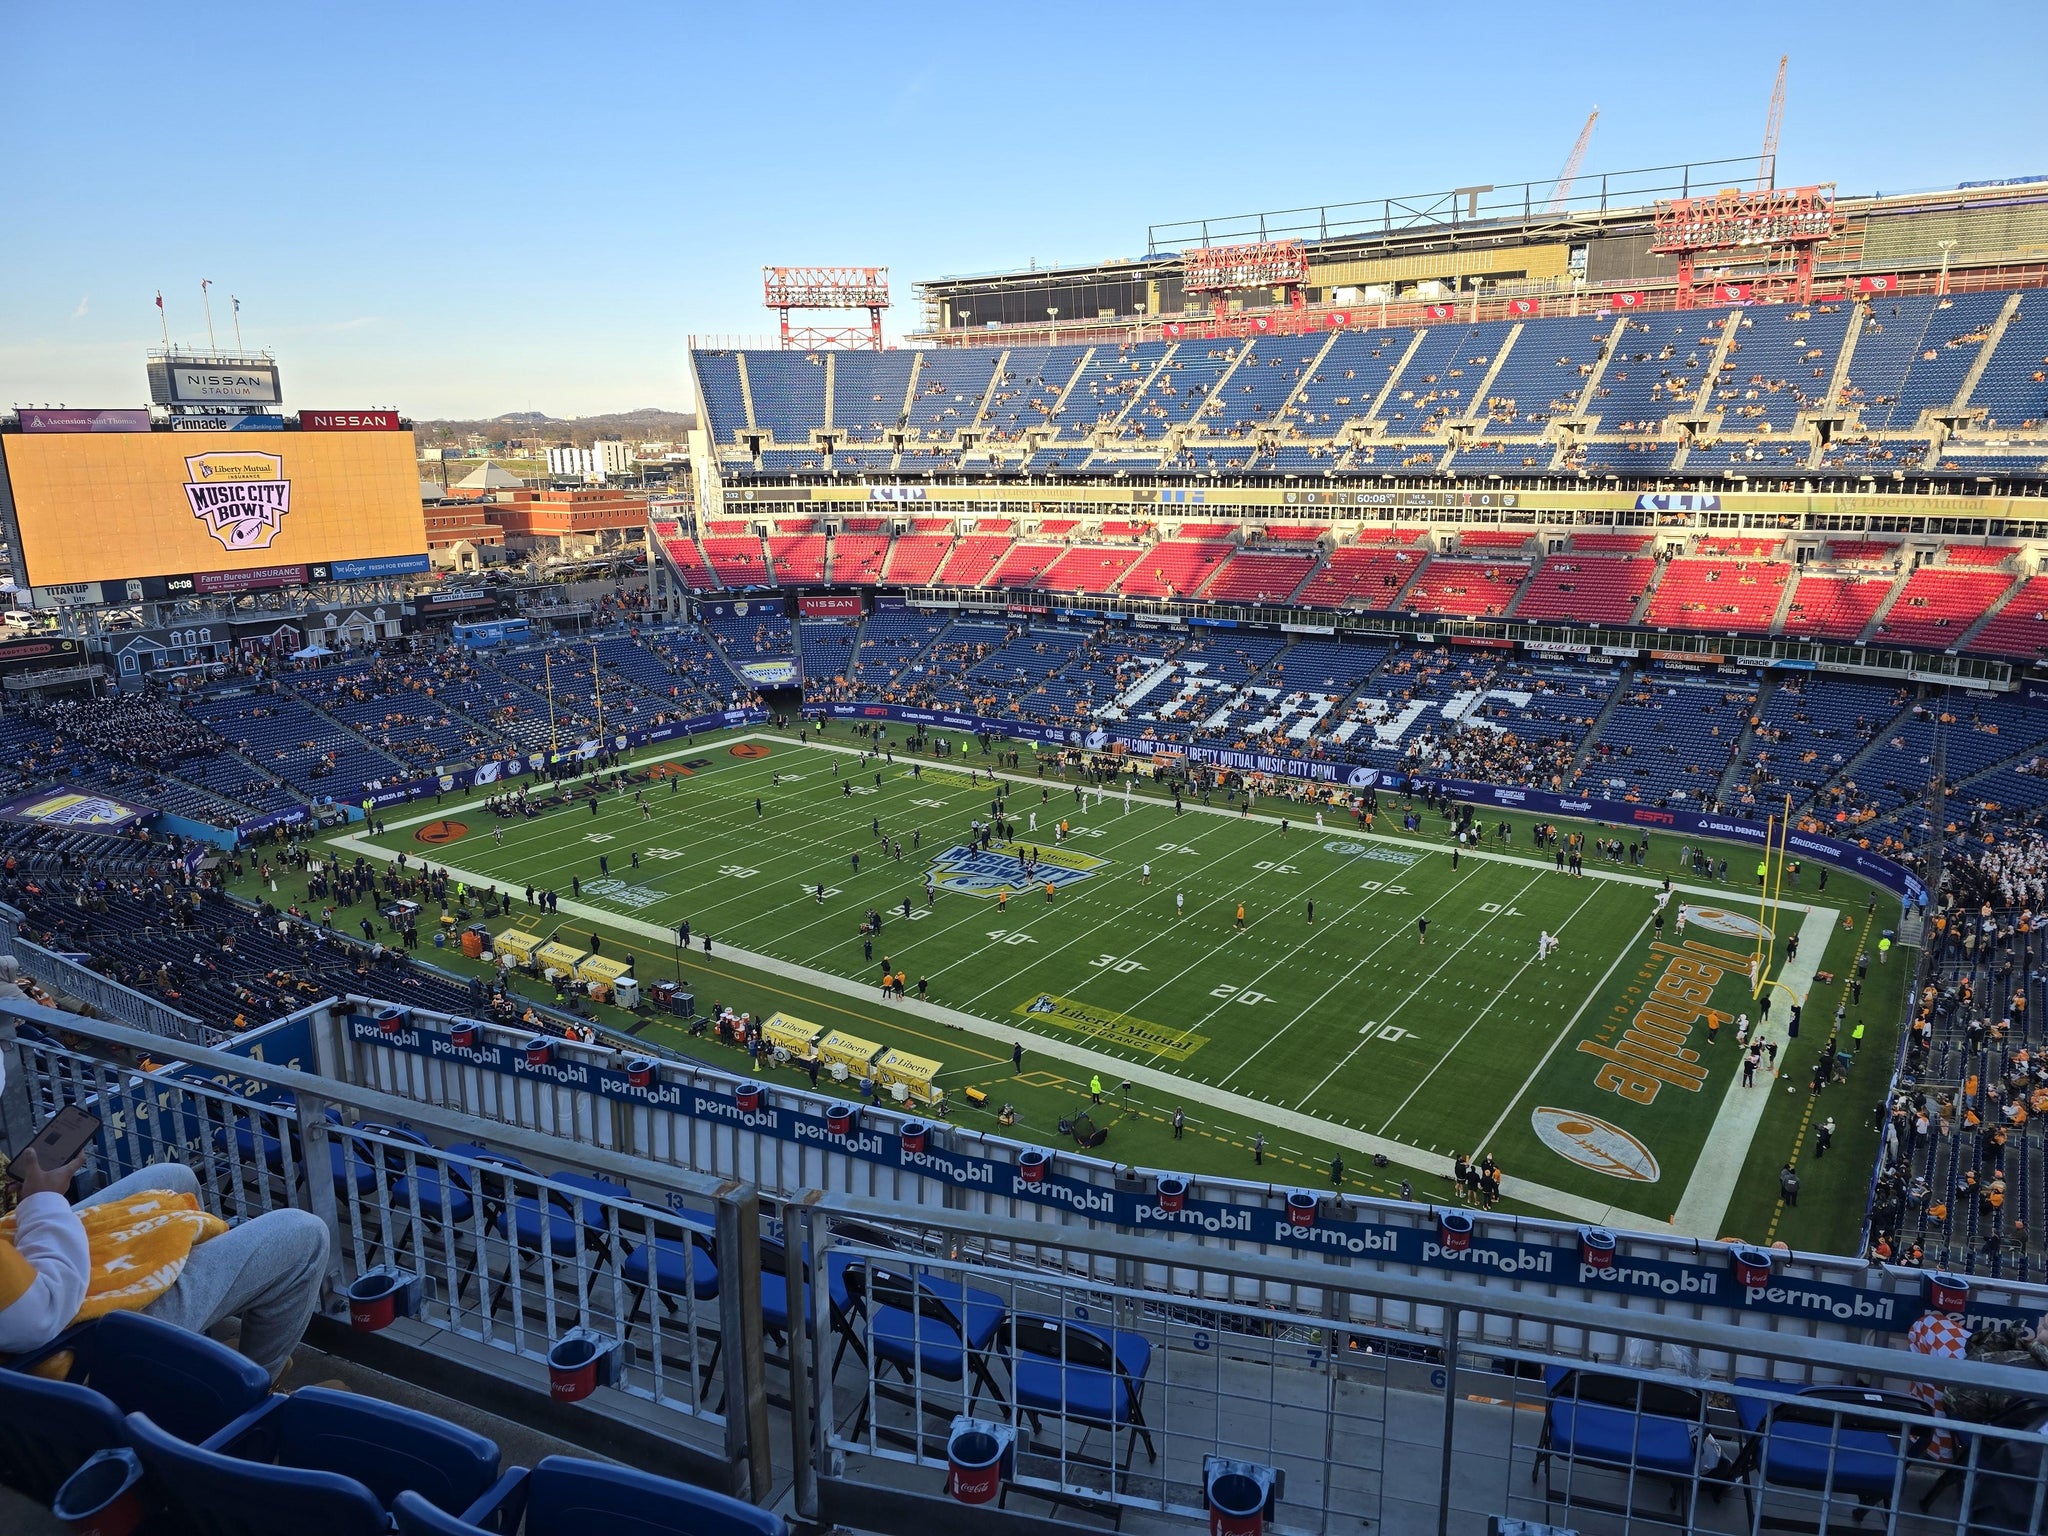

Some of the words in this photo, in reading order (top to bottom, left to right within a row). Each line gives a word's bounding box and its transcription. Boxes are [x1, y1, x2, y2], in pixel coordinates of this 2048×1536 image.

[187, 375, 260, 386] NISSAN
[202, 387, 251, 395] STADIUM
[173, 416, 227, 430] Pinnacle
[314, 416, 387, 426] NISSAN
[214, 466, 241, 474] Liberty
[190, 486, 246, 511] MUSIC
[247, 484, 286, 507] CITY
[1307, 493, 1315, 502] 0
[1357, 494, 1386, 503] 60:08
[1481, 495, 1490, 505] 0
[1862, 497, 1917, 512] Liberty
[217, 503, 269, 522] BOWL
[201, 575, 222, 583] Farm
[224, 572, 251, 581] Bureau
[253, 567, 300, 578] INSURANCE
[345, 563, 366, 575] Kroger
[45, 586, 75, 595] TITAN
[74, 585, 89, 593] UP
[806, 600, 853, 608] NISSAN
[1665, 663, 1701, 671] CAMPBELL
[1717, 667, 1747, 675] PHILLIPS
[1738, 657, 1769, 666] Pinnacle
[1966, 688, 1998, 699] Nashville
[864, 707, 888, 716] ESPN
[918, 713, 935, 721] DENTAL
[1116, 737, 1153, 754] WELCOME
[1155, 742, 1166, 752] TO
[1167, 744, 1183, 754] THE
[1185, 746, 1218, 763] LIBERTY
[1220, 752, 1256, 769] MUTUAL
[1257, 757, 1286, 773] MUSIC
[1288, 761, 1309, 777] CITY
[1311, 763, 1338, 781] BOWL
[378, 791, 397, 802] DELTA
[1560, 799, 1592, 810] Nashville
[1633, 809, 1674, 824] ESPN
[1068, 826, 1108, 838] 50
[1710, 822, 1734, 833] DELTA
[1735, 826, 1766, 838] DENTAL
[649, 847, 686, 860] 20
[1156, 842, 1192, 856] 40
[1789, 836, 1842, 858] BRIDGESTONE
[722, 865, 761, 879] 30
[958, 862, 1029, 887] BOWL
[1252, 859, 1297, 875] 30
[1360, 880, 1407, 896] 20
[886, 904, 935, 921] 50
[1478, 902, 1519, 917] 10
[986, 929, 1033, 945] 40
[1089, 953, 1143, 974] 30
[1627, 952, 1665, 994] MUSIC
[1209, 984, 1268, 1005] 20
[1057, 1007, 1122, 1034] Liberty
[1127, 1014, 1193, 1051] Mutual
[1358, 1020, 1409, 1042] 10
[1595, 1004, 1630, 1042] CITY
[1074, 1023, 1152, 1050] INSURANCE
[432, 1039, 501, 1065] permobil
[514, 1056, 588, 1084] permobil
[695, 1098, 778, 1129] permobil
[901, 1150, 993, 1184] permobil
[665, 1192, 684, 1209] 13
[1013, 1175, 1114, 1213] permobil
[1136, 1203, 1251, 1232] permobil
[1275, 1221, 1398, 1252] permobil
[1422, 1241, 1553, 1273] permobil
[1579, 1263, 1718, 1295] permobil
[1746, 1286, 1895, 1320] permobil
[1193, 1332, 1210, 1351] 8
[1306, 1349, 1323, 1368] 7
[1430, 1369, 1447, 1390] 6
[960, 1480, 990, 1495] Coca-Cola
